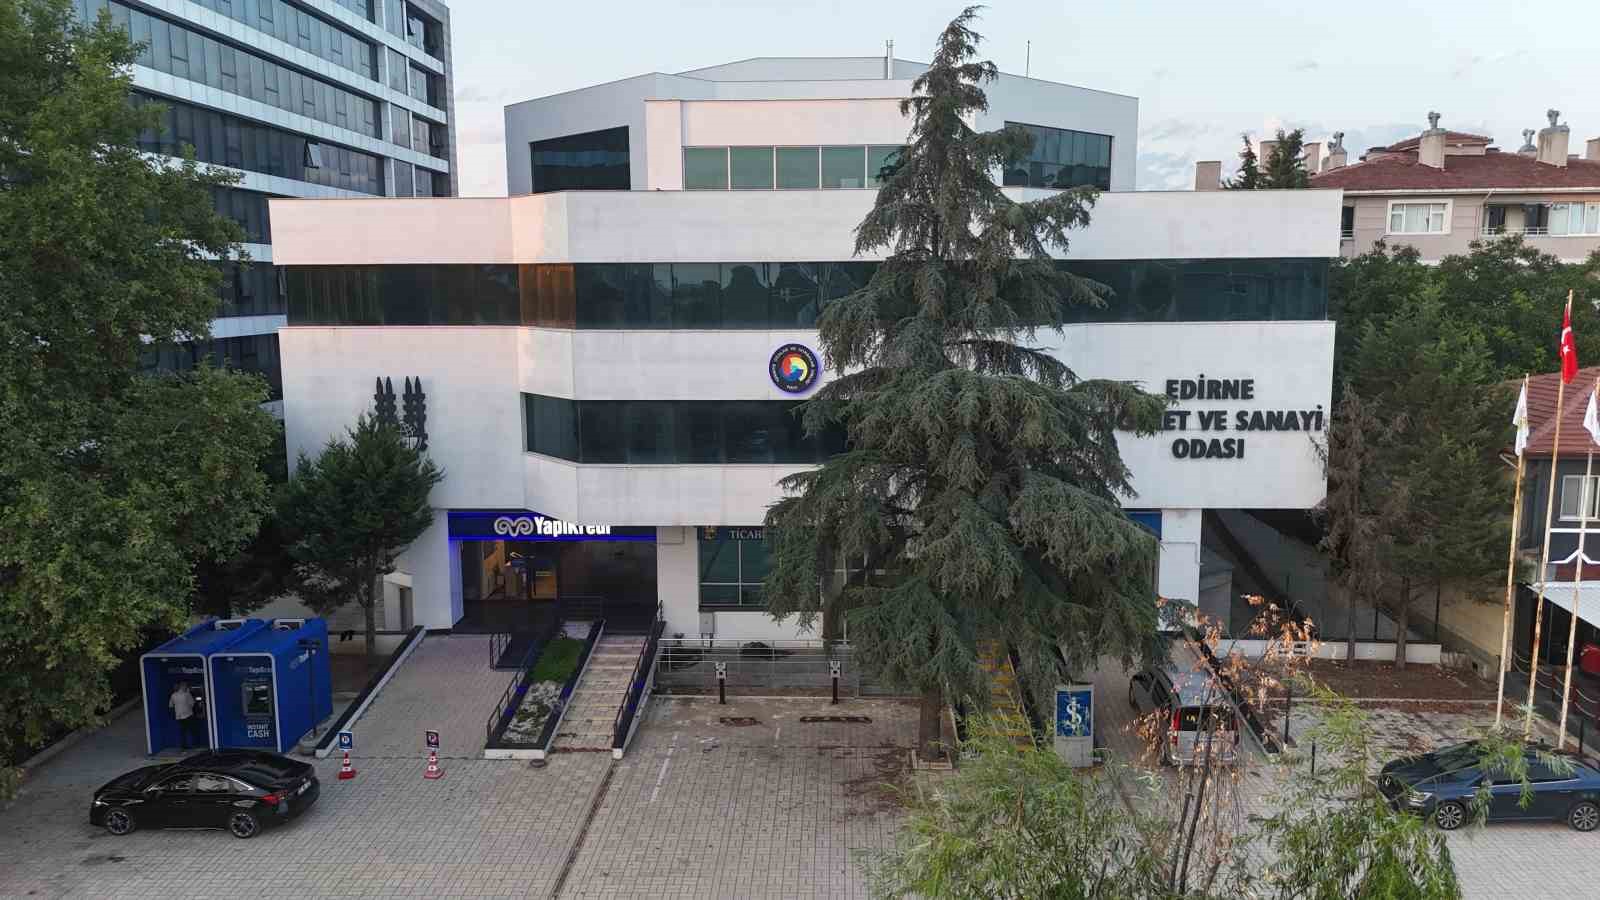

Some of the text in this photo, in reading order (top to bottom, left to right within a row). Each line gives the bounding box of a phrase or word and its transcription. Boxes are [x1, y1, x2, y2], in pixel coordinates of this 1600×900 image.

[1166, 373, 1255, 401] EDİRNE
[1198, 411, 1227, 431] VE
[1235, 404, 1324, 432] SANAYİ
[1171, 438, 1246, 460] ODASI
[247, 730, 270, 738] CASH
